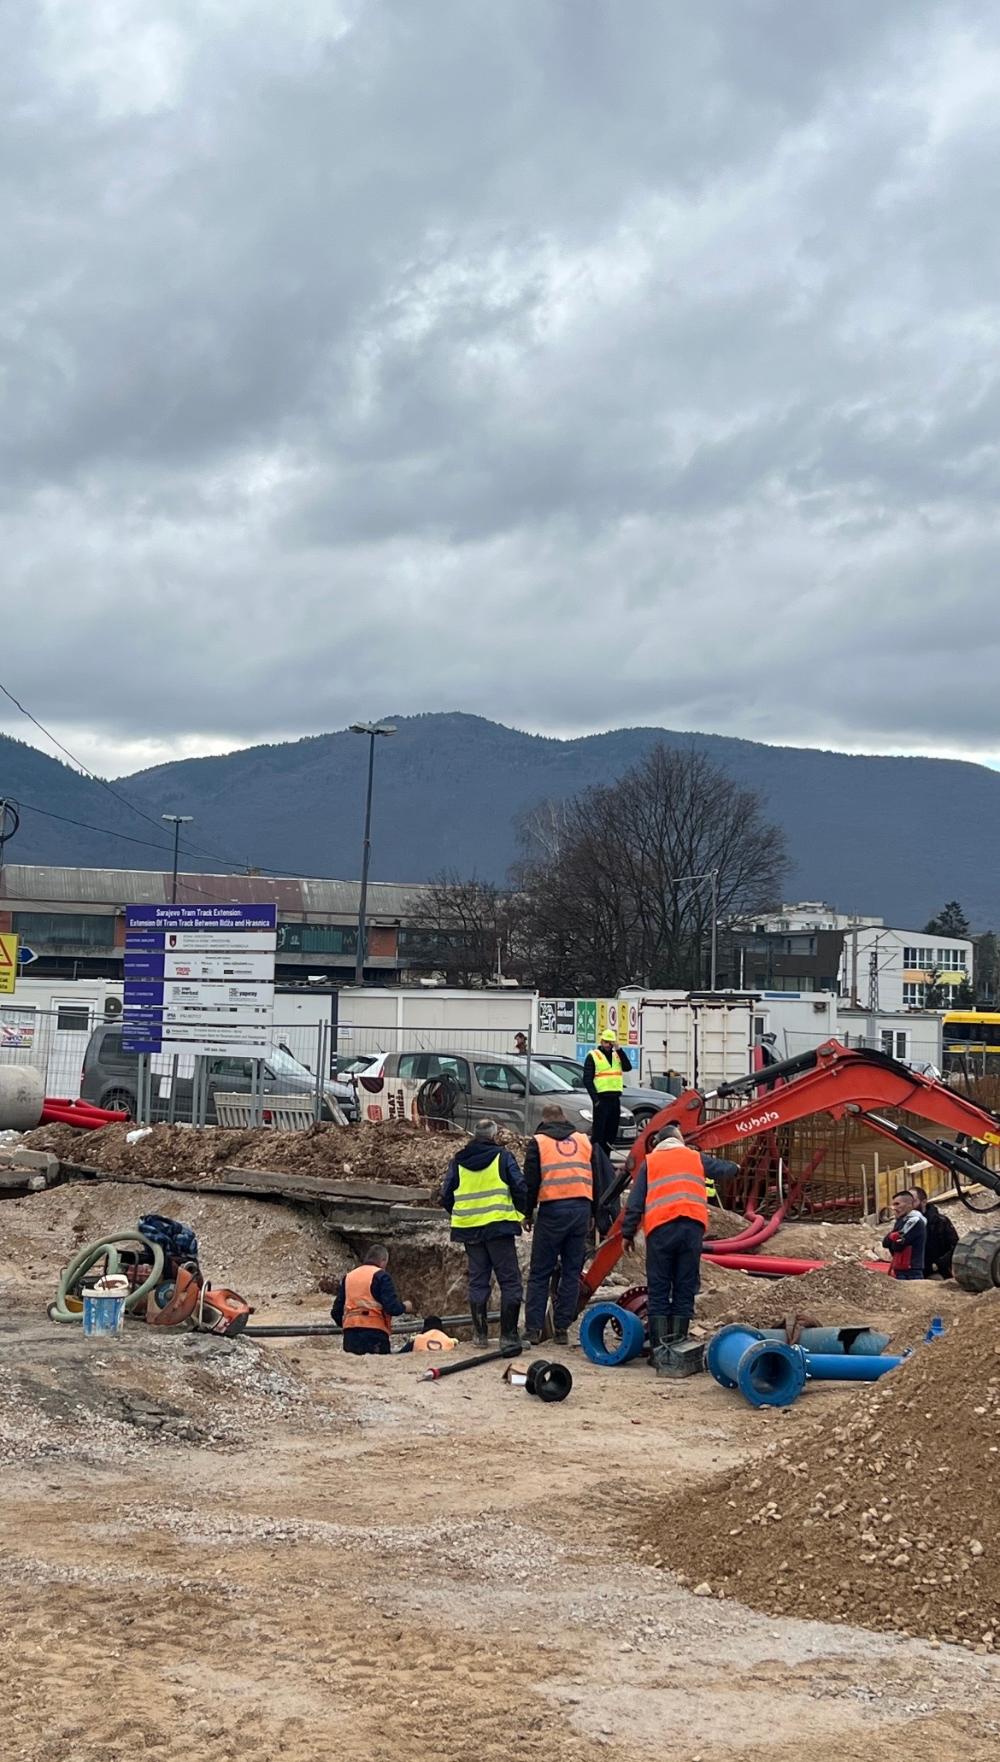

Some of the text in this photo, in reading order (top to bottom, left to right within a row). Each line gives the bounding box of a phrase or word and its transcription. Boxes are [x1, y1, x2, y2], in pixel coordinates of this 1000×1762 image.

[156, 908, 180, 918] Sarajevo
[181, 908, 195, 916] Tram
[196, 908, 212, 916] Track
[129, 919, 156, 927] Extension
[163, 919, 178, 927] Tram
[178, 919, 194, 927] Track
[194, 919, 219, 927] Between
[234, 919, 246, 927] and
[246, 919, 270, 927] Hrasnica
[735, 1111, 779, 1132] Kubota
